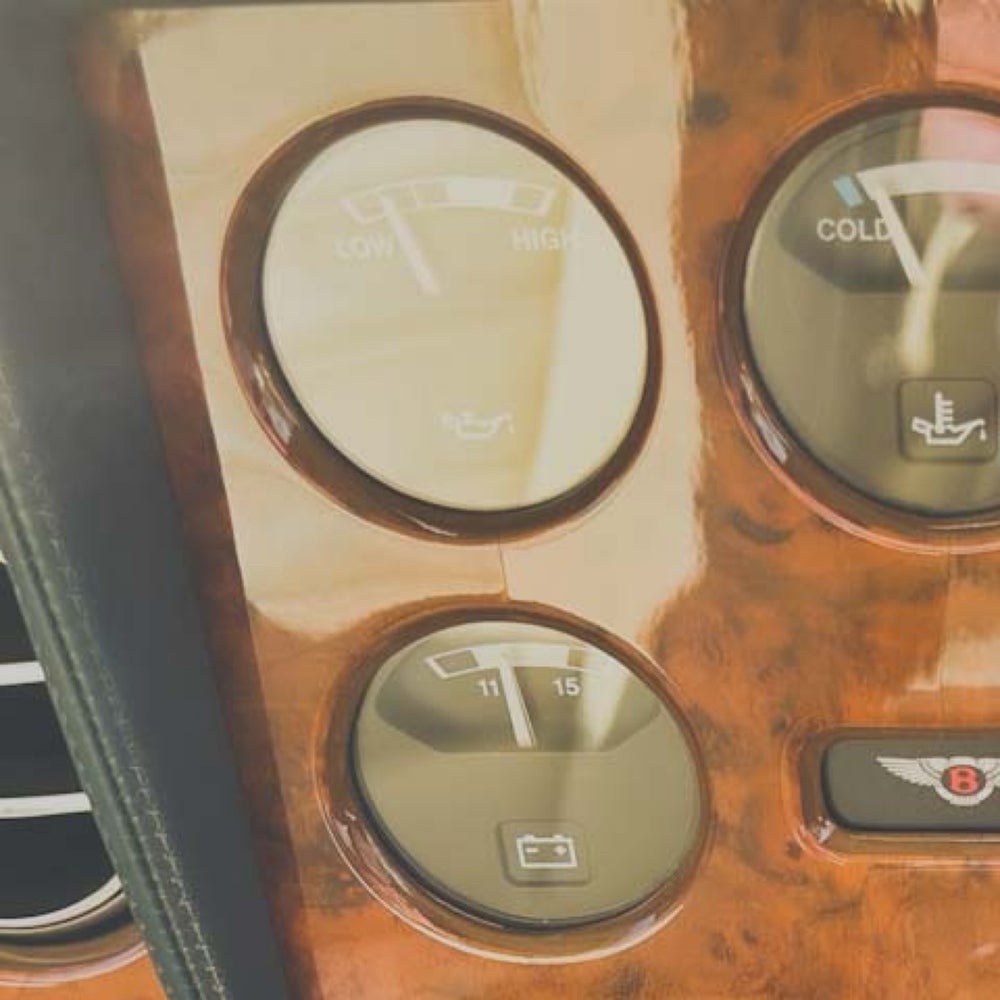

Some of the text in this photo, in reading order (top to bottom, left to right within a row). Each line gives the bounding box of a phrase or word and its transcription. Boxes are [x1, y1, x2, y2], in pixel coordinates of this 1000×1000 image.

[816, 217, 892, 243] COLD
[477, 679, 499, 697] 11
[552, 677, 582, 697] 15
[949, 763, 980, 795] B
